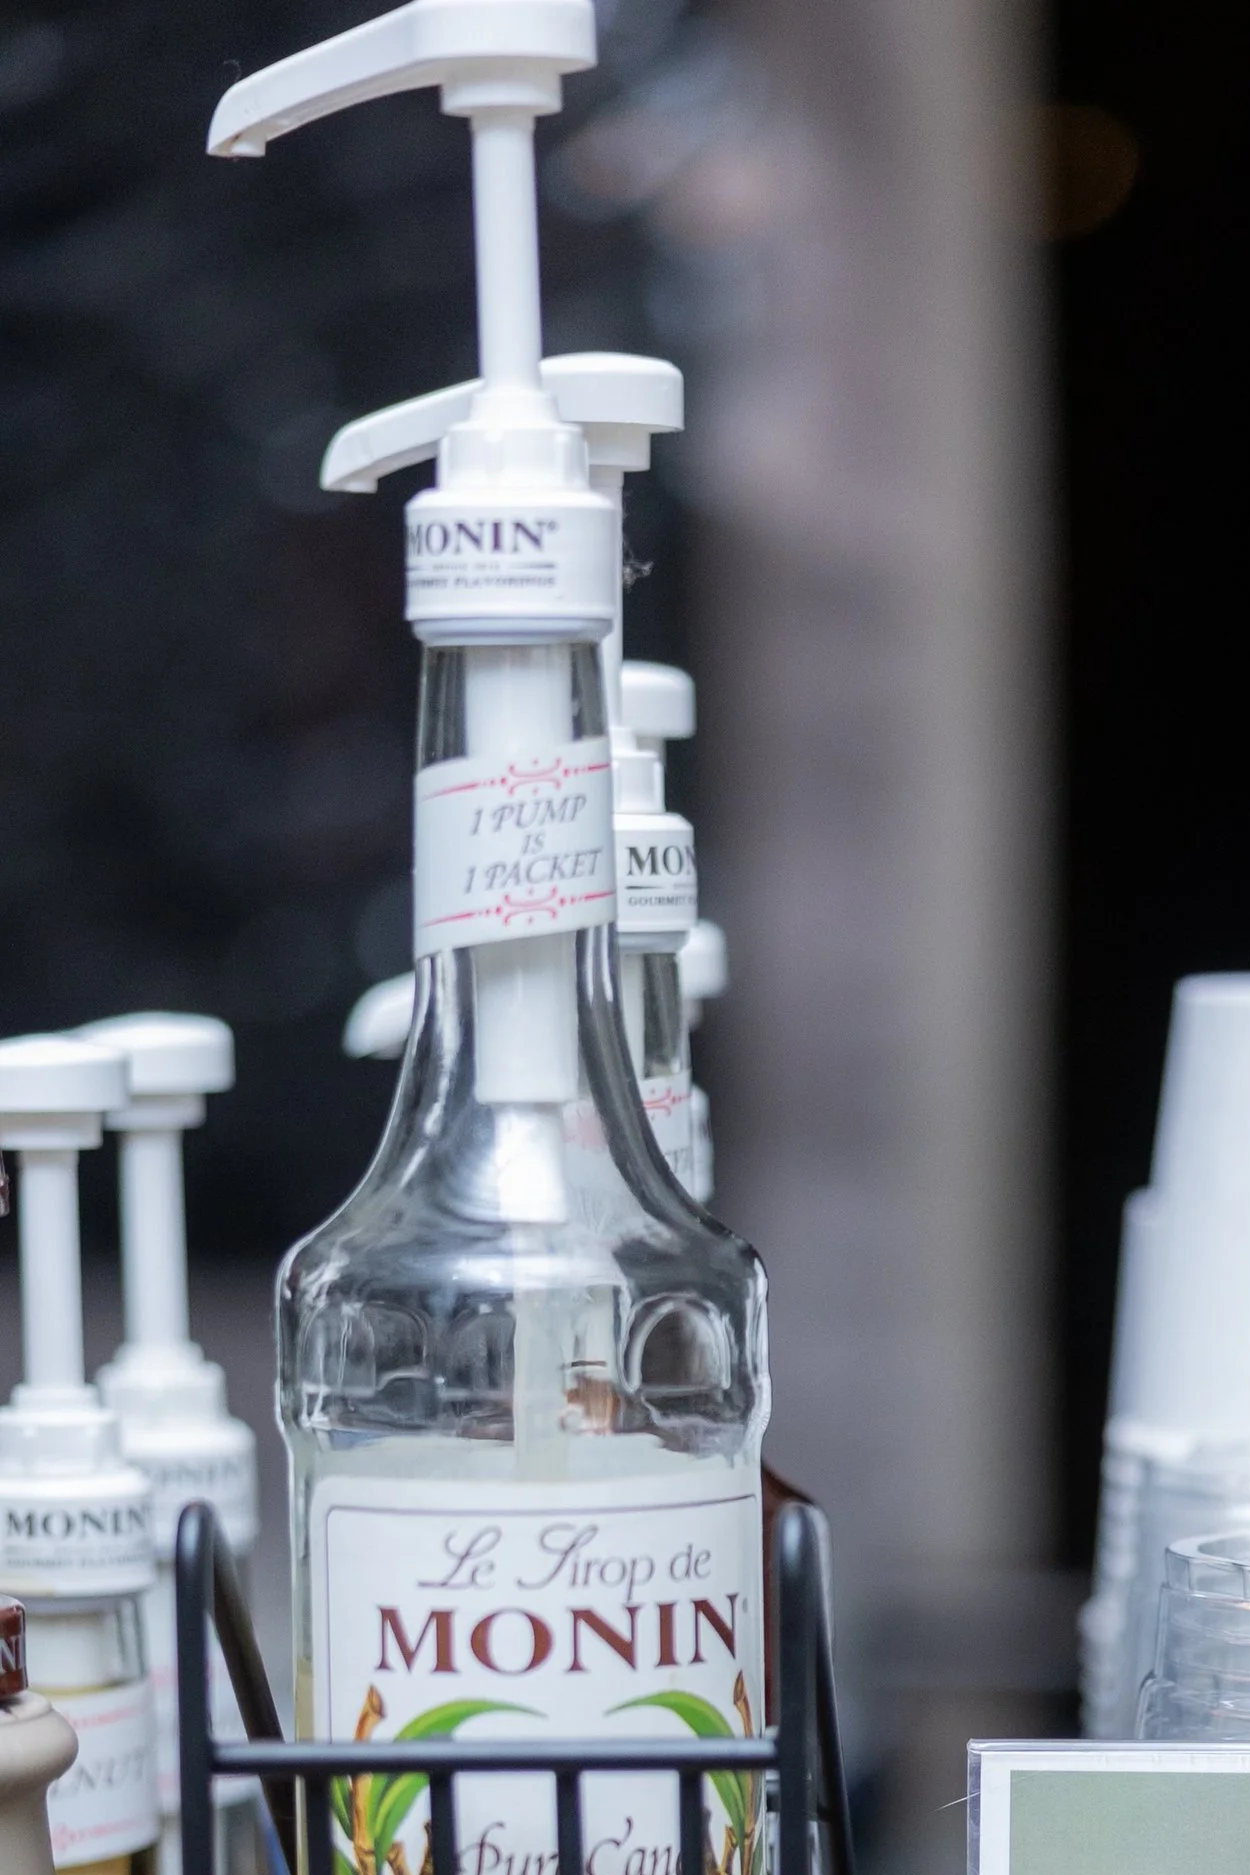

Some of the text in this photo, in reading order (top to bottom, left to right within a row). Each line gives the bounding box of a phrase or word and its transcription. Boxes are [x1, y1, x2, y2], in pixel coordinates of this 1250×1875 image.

[468, 794, 587, 837] 1 PUMP
[522, 832, 546, 856] IS
[462, 846, 603, 894] 1 PACKET
[416, 1523, 712, 1602] Le Sirop de
[375, 1592, 740, 1676] MONIN
